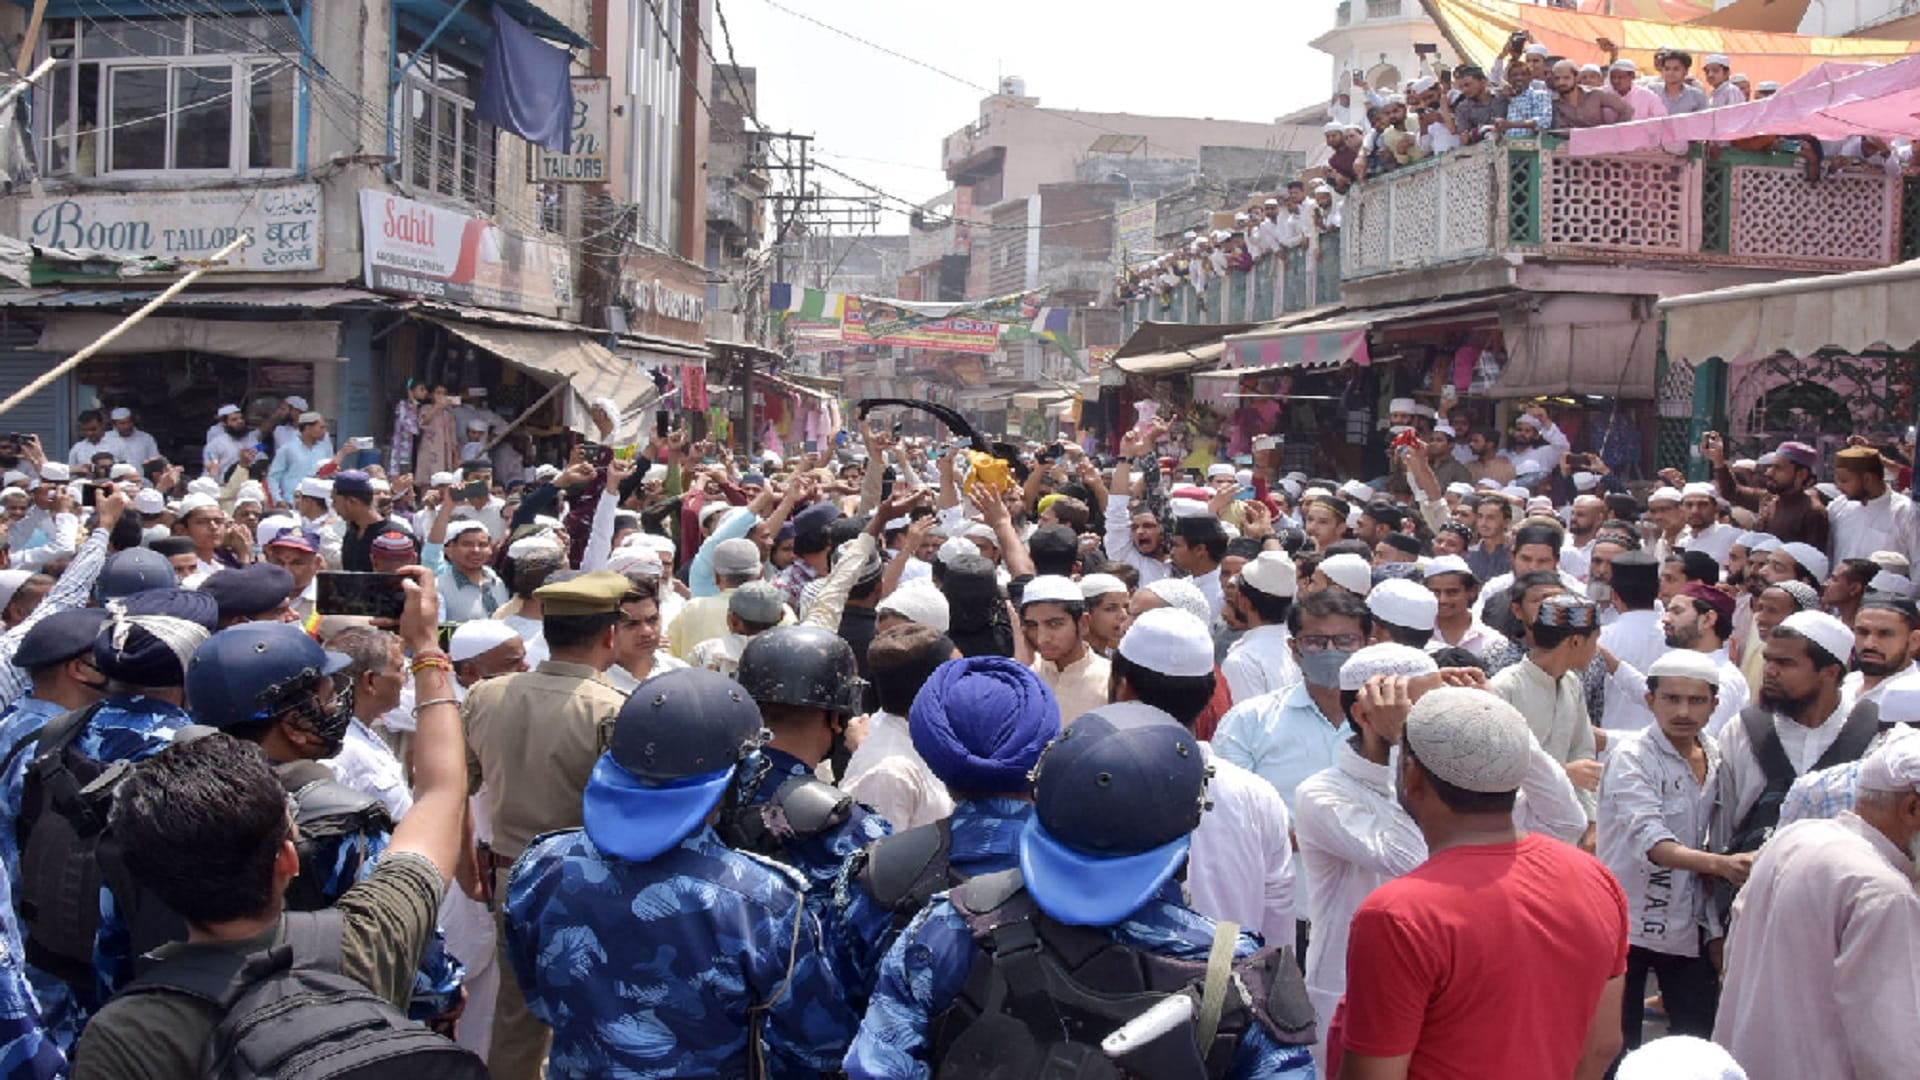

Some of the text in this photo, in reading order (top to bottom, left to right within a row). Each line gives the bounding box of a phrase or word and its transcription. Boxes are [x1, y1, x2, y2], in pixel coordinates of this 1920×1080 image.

[543, 157, 602, 178] TAILORS
[31, 200, 256, 251] Boon TAILORS
[384, 198, 435, 247] Sahil
